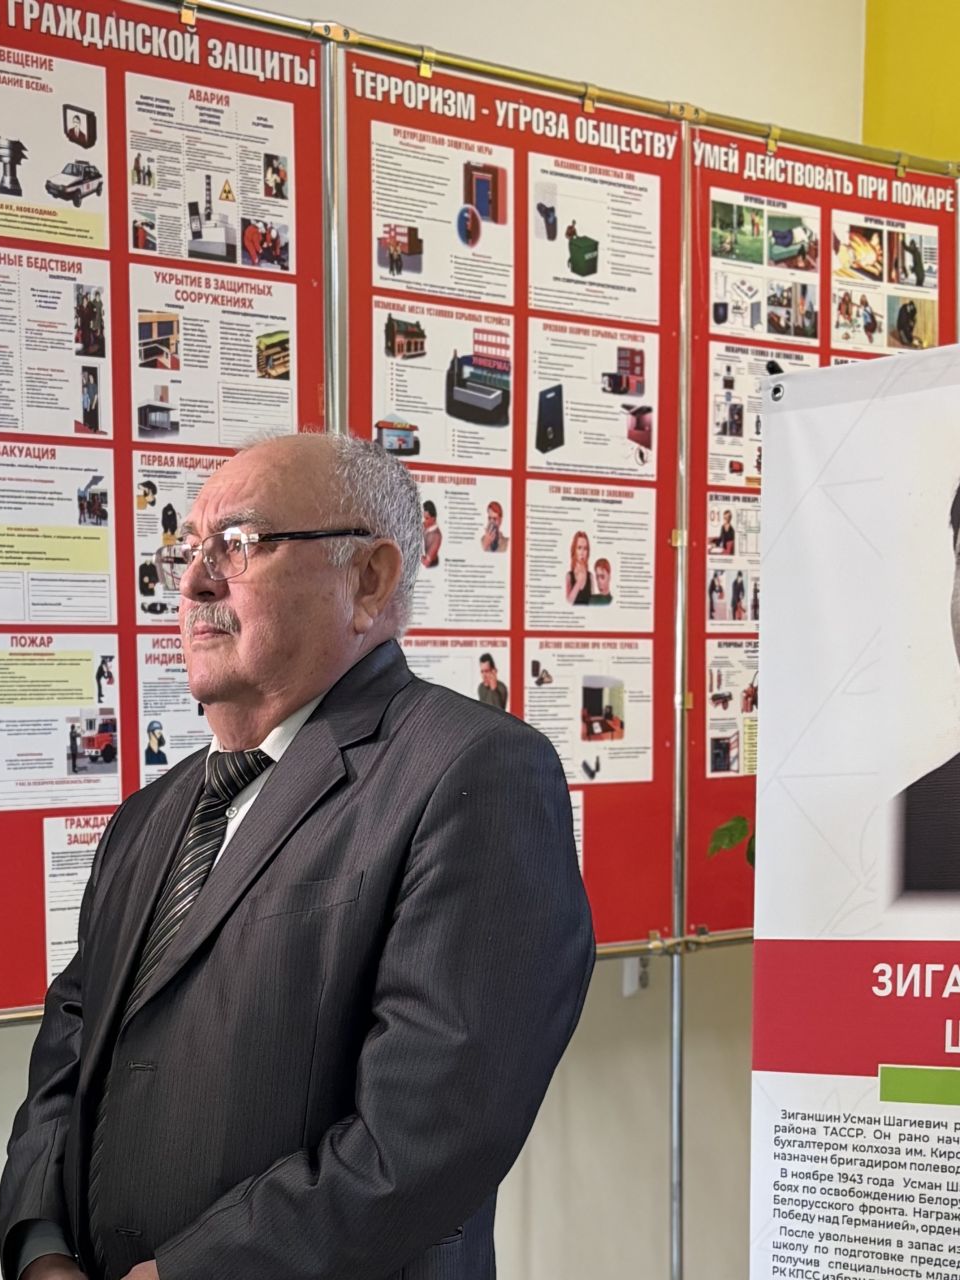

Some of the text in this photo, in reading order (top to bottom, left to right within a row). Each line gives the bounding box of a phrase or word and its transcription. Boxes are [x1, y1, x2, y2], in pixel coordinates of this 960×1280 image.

[8, 0, 200, 65] ГРАЖДАНСКОЙ
[207, 38, 316, 88] ЗАЩИТЫ
[188, 89, 231, 109] АВАРИЯ
[353, 66, 677, 160] ТЕРРОРИЗМ УГРОЗА ОБЩЕСТВУ
[693, 140, 955, 212] УМЕЙ ДЕЙСТВОВАТЬ ПРИ ПОЖАРЕ
[26, 253, 83, 275] БЕДСТВИЯ
[154, 271, 273, 297] УКРЫТИЕ В ЗАЩИТНЫХ
[174, 290, 254, 310] СООРУЖЕНИЯХ
[141, 454, 228, 470] ПЕРВАЯ МЕДИЦИН
[10, 635, 54, 649] ПОЖАР
[67, 833, 101, 846] ЗАЩИТ
[781, 1109, 948, 1129] Зиганшин Усман Шагиевич
[774, 1124, 929, 1143] района ТАССР. рано
[774, 1136, 901, 1155] бухгалтером колхоза
[774, 1152, 907, 1170] назначен бригадиром
[791, 1170, 941, 1191] ноябре 1943 года Усман
[773, 1181, 914, 1203] боях освобождению
[774, 1195, 908, 1216] Белорусского фронта.
[773, 1208, 919, 1233] Победу Германией»,
[780, 1226, 943, 1252] После увольнения запас
[772, 1241, 904, 1262] школу подготовке
[772, 1254, 922, 1278] получив специальность
[789, 1268, 820, 1280] КПСС
